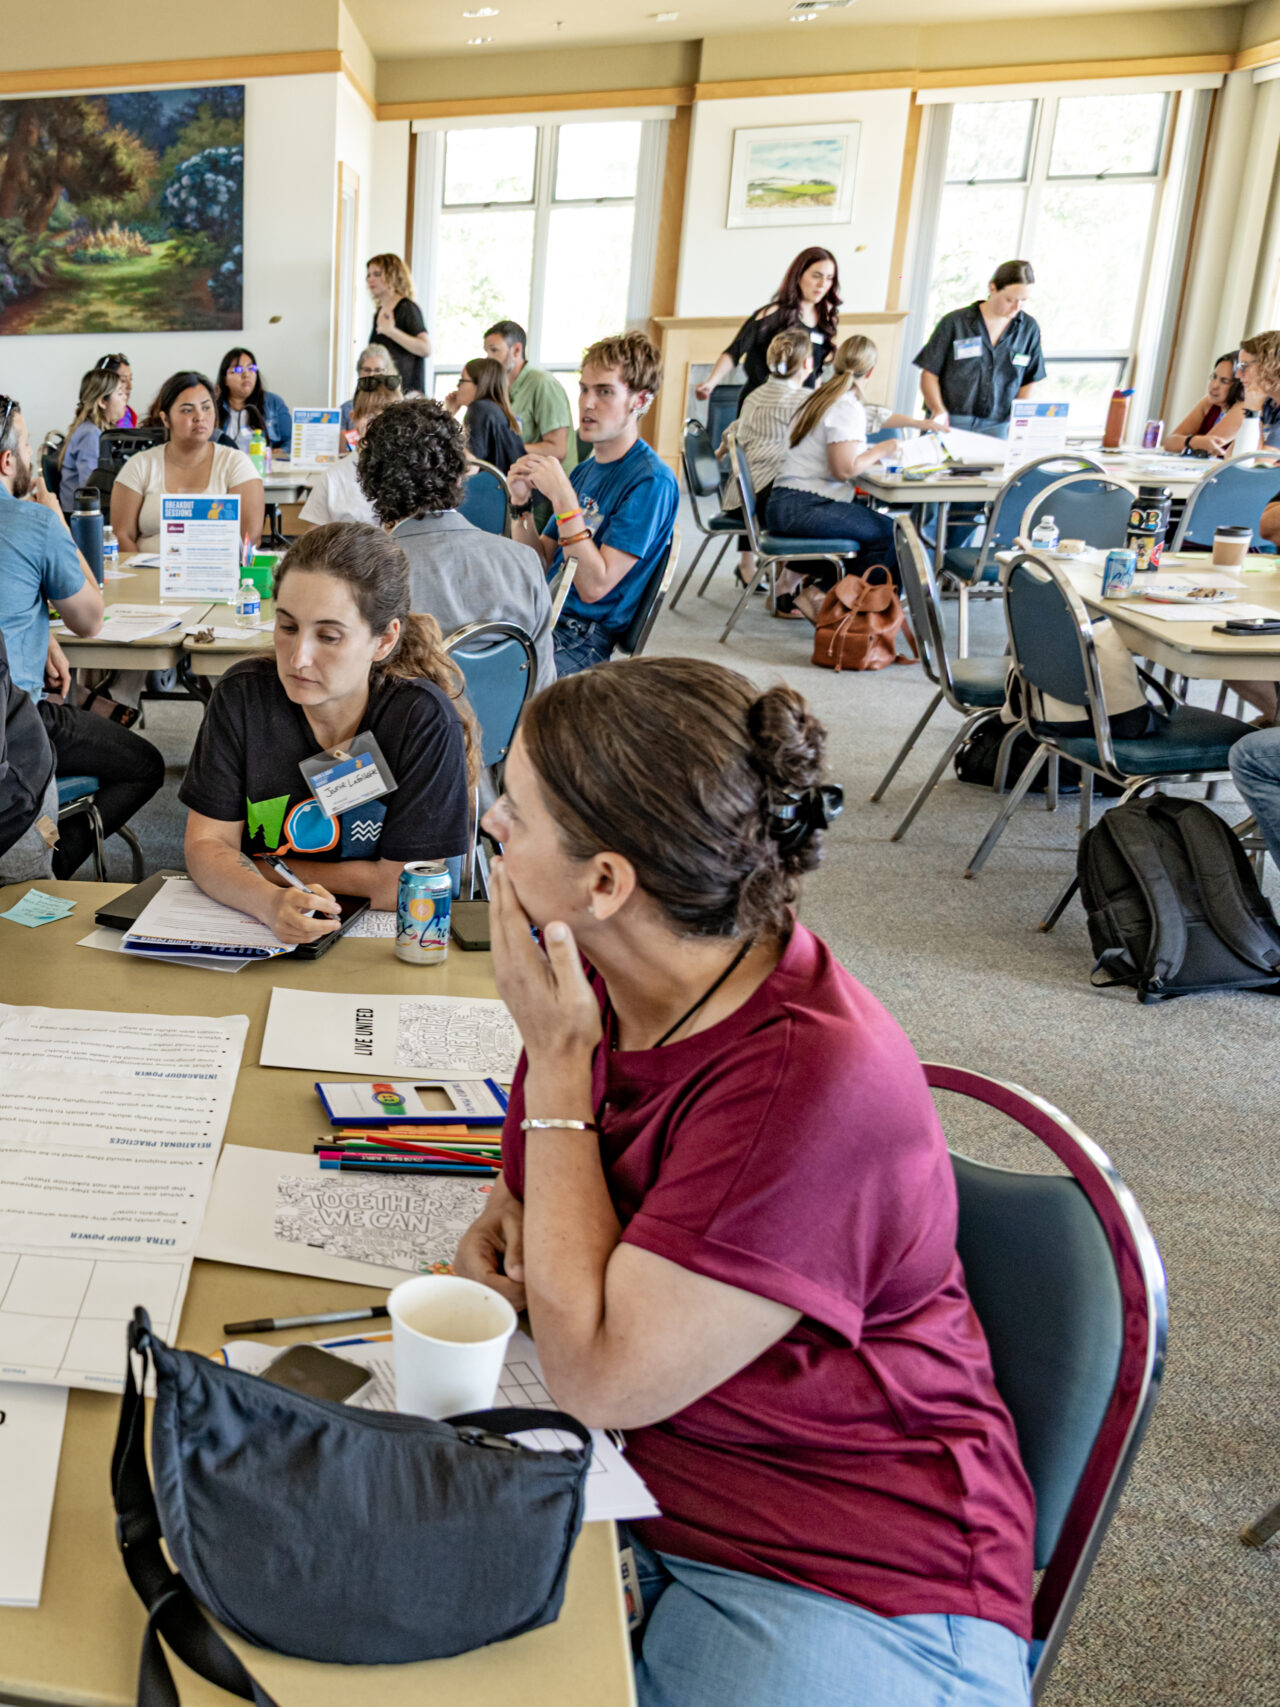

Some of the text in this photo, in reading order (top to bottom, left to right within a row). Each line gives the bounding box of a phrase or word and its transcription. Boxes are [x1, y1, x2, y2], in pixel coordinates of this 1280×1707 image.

[165, 501, 194, 509] BREAKOUT
[164, 509, 193, 517] SESSIONS
[354, 1008, 374, 1056] LIVE UNITED
[108, 1137, 211, 1149] RELATIONAL PRACTICES
[303, 1190, 443, 1217] TOGETHER
[318, 1210, 430, 1233] WE CAN
[69, 1231, 176, 1246] EXTRA-GROUP POWER
